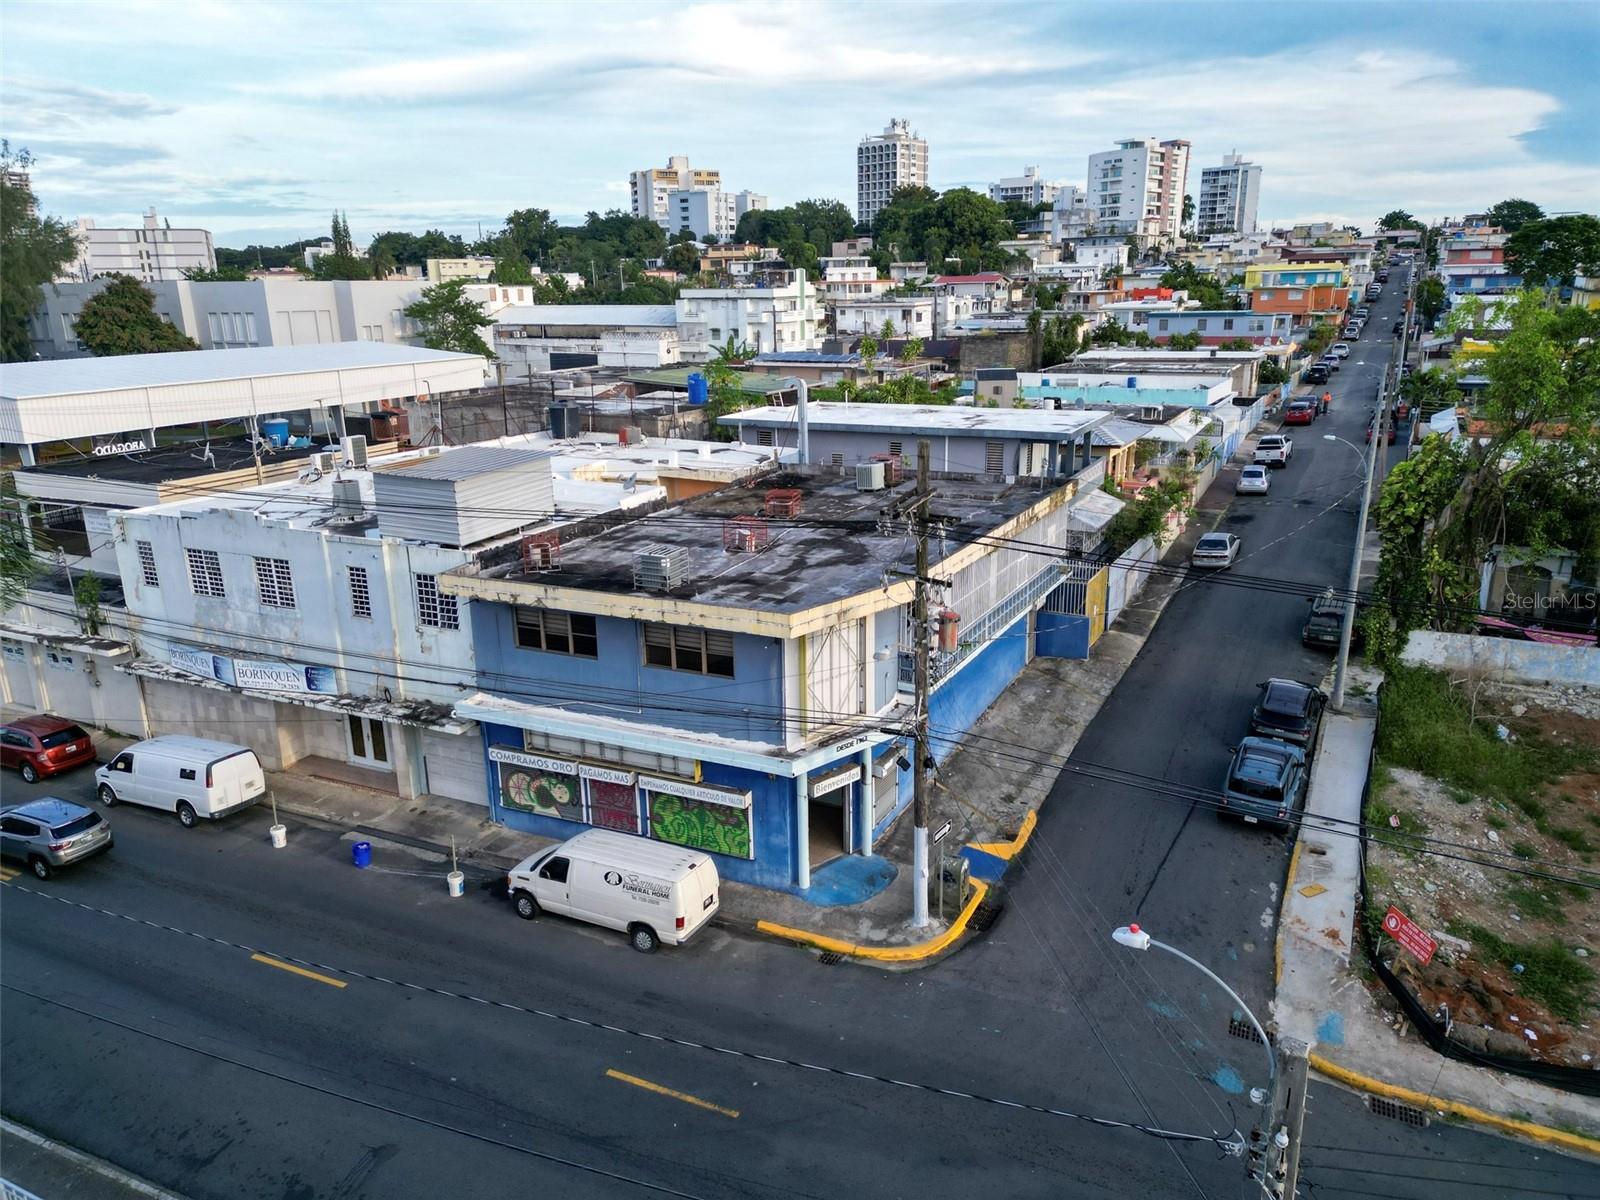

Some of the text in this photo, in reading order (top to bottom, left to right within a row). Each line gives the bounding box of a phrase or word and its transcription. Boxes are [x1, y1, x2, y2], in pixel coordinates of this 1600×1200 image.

[238, 668, 301, 682] BORINQUEN
[836, 740, 855, 752] DESDE
[490, 750, 573, 773] COMPRAMOS ORO
[580, 767, 630, 784] PAGAMOS MAS
[815, 771, 860, 794] Bienvenidos
[670, 785, 696, 796] CUALQUIER
[622, 884, 670, 900] FUNERAL HOME
